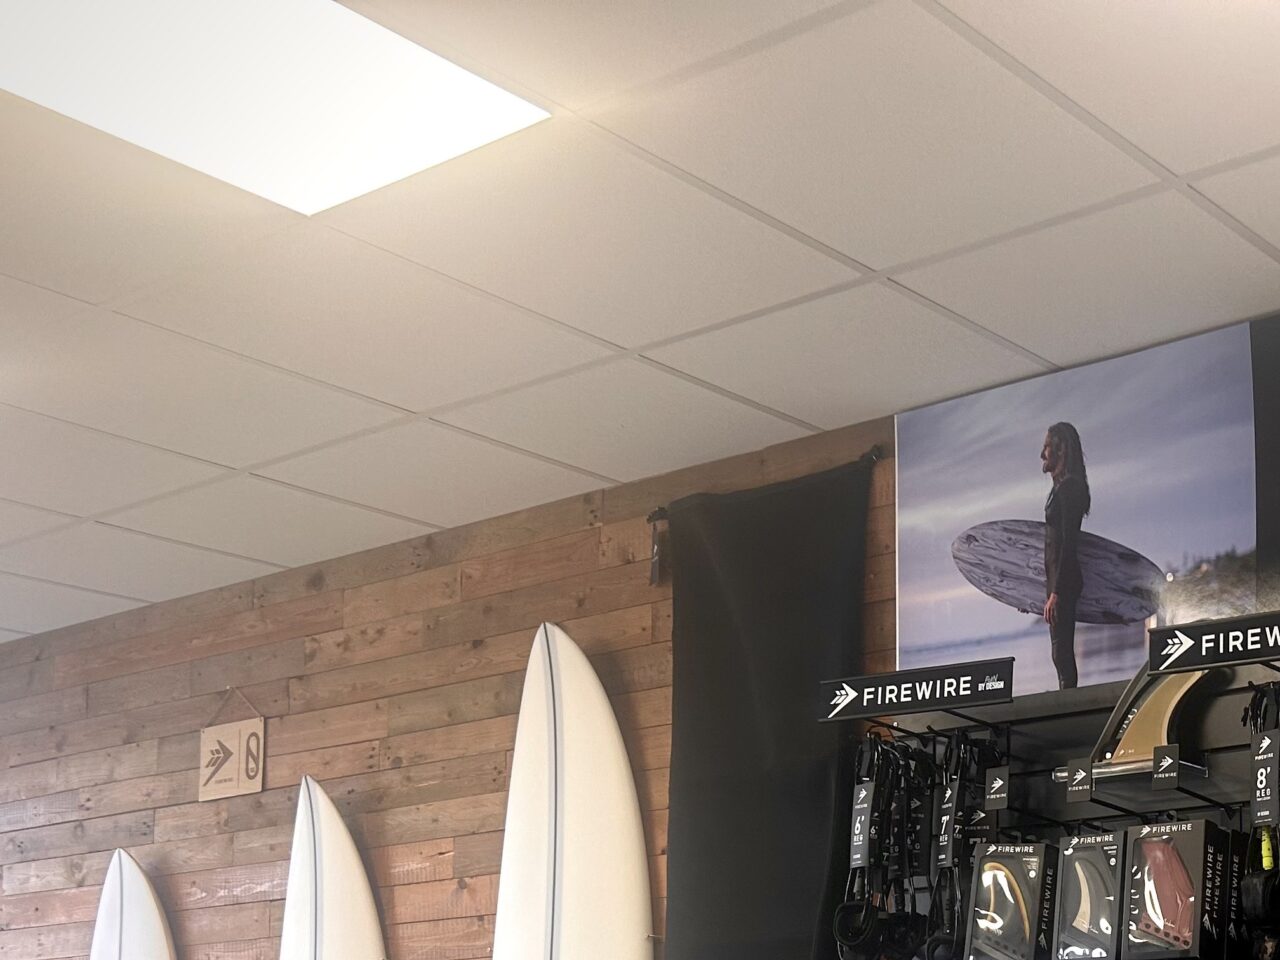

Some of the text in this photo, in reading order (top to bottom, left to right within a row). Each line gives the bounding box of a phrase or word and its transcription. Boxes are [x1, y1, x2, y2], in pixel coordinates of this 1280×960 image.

[863, 676, 972, 707] FIREWIRE
[978, 680, 1005, 692] BY DESIGN
[1153, 771, 1177, 779] FIREWIRE
[1256, 766, 1271, 789] 8'
[1068, 784, 1090, 792] FIREWIRE
[1256, 788, 1271, 798] REG
[854, 815, 865, 834] 6'
[1152, 823, 1193, 834] FIREWIRE
[853, 834, 864, 842] REG
[1080, 834, 1114, 844] FIREWIRE
[997, 845, 1034, 853] FIREWIRE
[1205, 844, 1214, 911] FIREWIRE
[1230, 855, 1239, 919] FIREWIRE
[1042, 867, 1054, 930] FIREWIRE
